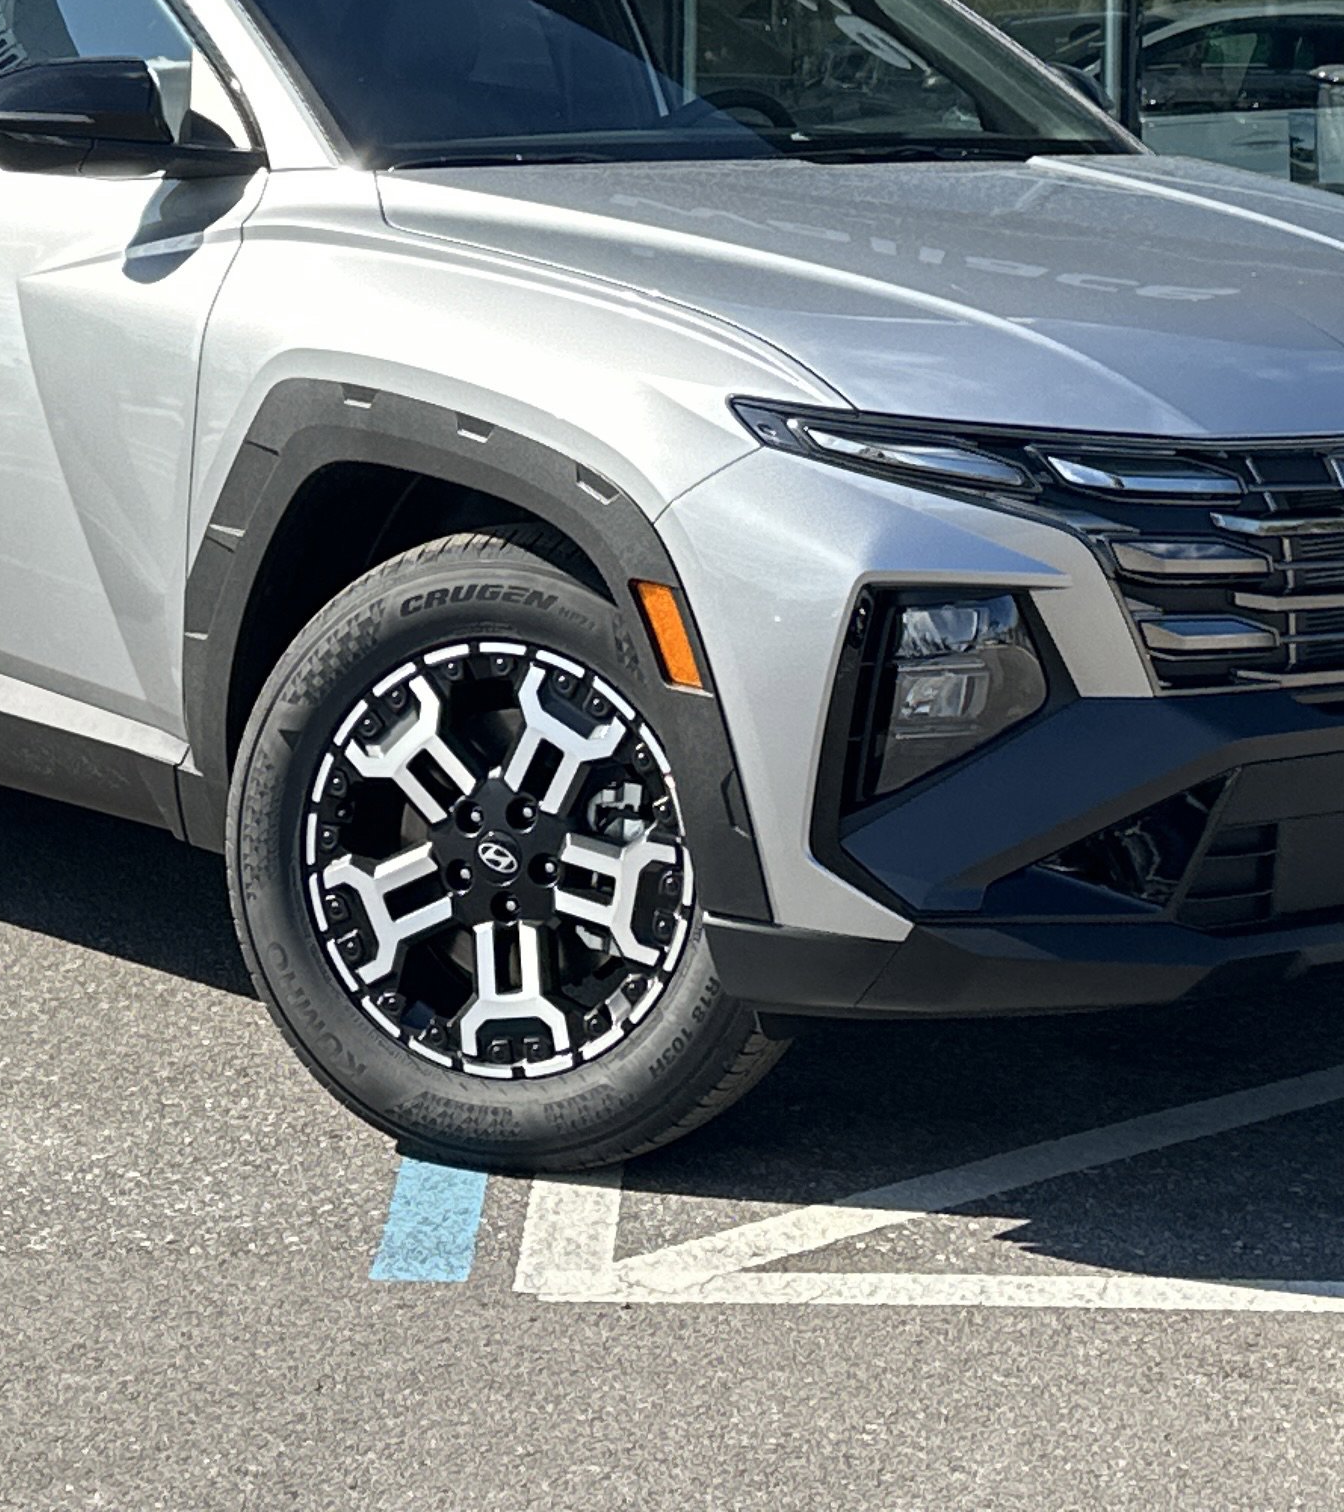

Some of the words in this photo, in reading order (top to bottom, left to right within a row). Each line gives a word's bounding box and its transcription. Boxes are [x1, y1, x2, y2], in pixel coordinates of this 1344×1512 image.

[399, 584, 559, 617] CRUGEN
[267, 942, 366, 1076] KUMHO
[692, 976, 721, 1023] R18
[648, 1027, 693, 1079] 103H
